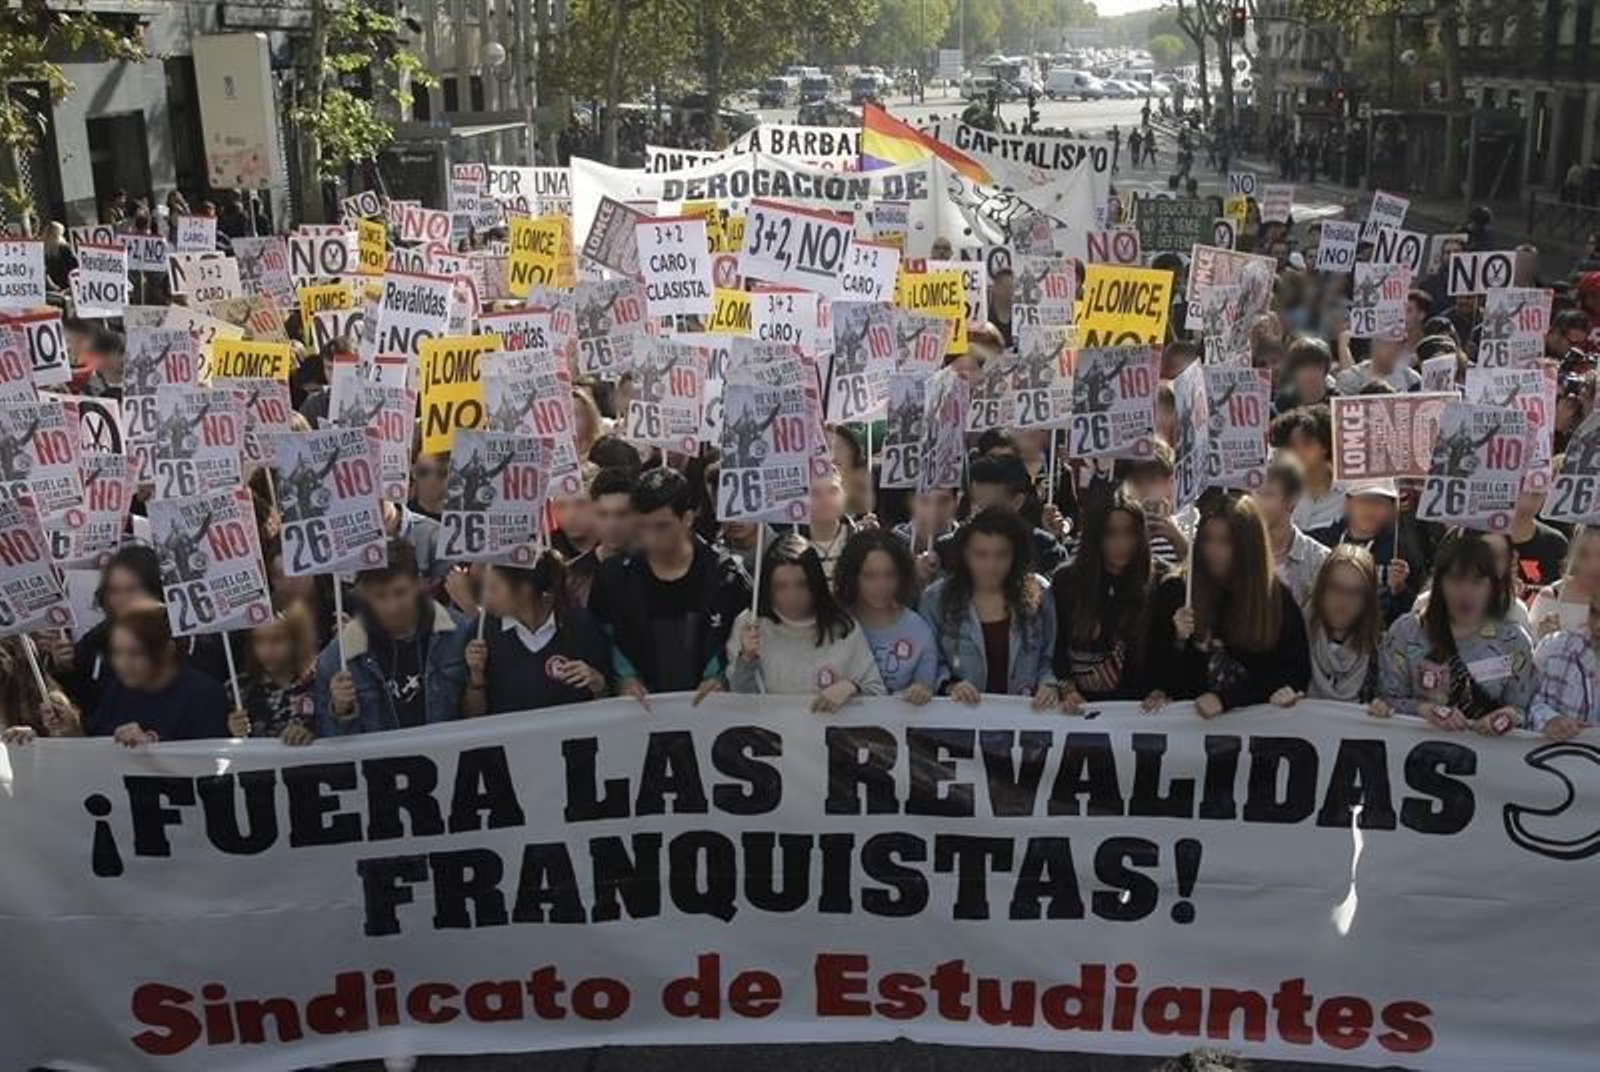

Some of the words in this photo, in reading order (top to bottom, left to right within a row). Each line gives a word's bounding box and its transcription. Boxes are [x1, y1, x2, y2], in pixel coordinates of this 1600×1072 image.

[489, 170, 521, 194] POR
[535, 170, 570, 196] UNA
[883, 171, 928, 200] DE
[1230, 174, 1254, 194] NO
[344, 193, 379, 218] NO
[404, 209, 450, 240] NO
[587, 204, 616, 256] LOMCE
[291, 238, 348, 275] NO
[650, 255, 688, 274] CARO
[797, 222, 850, 273] NO!
[1088, 231, 1137, 264] NO
[1372, 230, 1420, 270] NO
[843, 274, 874, 294] CARO
[1045, 274, 1068, 299] NO
[1451, 253, 1512, 290] NO
[384, 281, 449, 323] Reválidas,
[647, 280, 710, 301] CLASISTA.
[908, 281, 961, 311] ¡LOMCE,
[1086, 279, 1163, 323] ¡LOMCE,
[1382, 280, 1402, 300] NO
[613, 298, 641, 325] NO
[1353, 308, 1377, 335] 26
[1519, 307, 1542, 332] NO
[760, 323, 793, 342] CARO
[865, 324, 893, 360] NO
[164, 352, 192, 384] NO
[424, 348, 495, 394] ¡LOMC
[581, 337, 613, 371] 26
[1482, 340, 1509, 368] 26
[669, 366, 697, 399] NO
[837, 374, 869, 420] 26
[1118, 366, 1151, 400] NO
[124, 396, 158, 438] 26
[255, 398, 287, 424] NO
[531, 399, 567, 434] NO
[630, 401, 662, 440] 26
[970, 400, 999, 430] 26
[1017, 390, 1050, 426] 26
[1229, 394, 1260, 428] NO
[32, 429, 73, 466] NO
[203, 414, 236, 448] NO
[772, 415, 806, 454] NO
[1073, 413, 1110, 455] 26
[1343, 400, 1368, 476] LOMCE
[886, 445, 920, 484] 26
[1486, 437, 1523, 471] NO
[90, 480, 123, 512] NO
[158, 460, 196, 499] 26
[333, 458, 373, 500] NO
[503, 465, 539, 501] NO
[721, 469, 762, 518] 26
[1551, 476, 1595, 517] 26
[1426, 478, 1467, 518] 26
[207, 521, 251, 562] NO
[285, 519, 332, 574] 26
[444, 513, 486, 556] 26
[167, 580, 217, 632] 26
[84, 745, 526, 878] ¡FUERA
[562, 725, 783, 823] LAS
[824, 725, 1478, 835] REVALIDAS
[356, 829, 1203, 938] FRANQUISTAS!
[130, 966, 631, 1057] Sindicato
[660, 952, 783, 1020] de
[813, 952, 1434, 1053] Estudiantes
